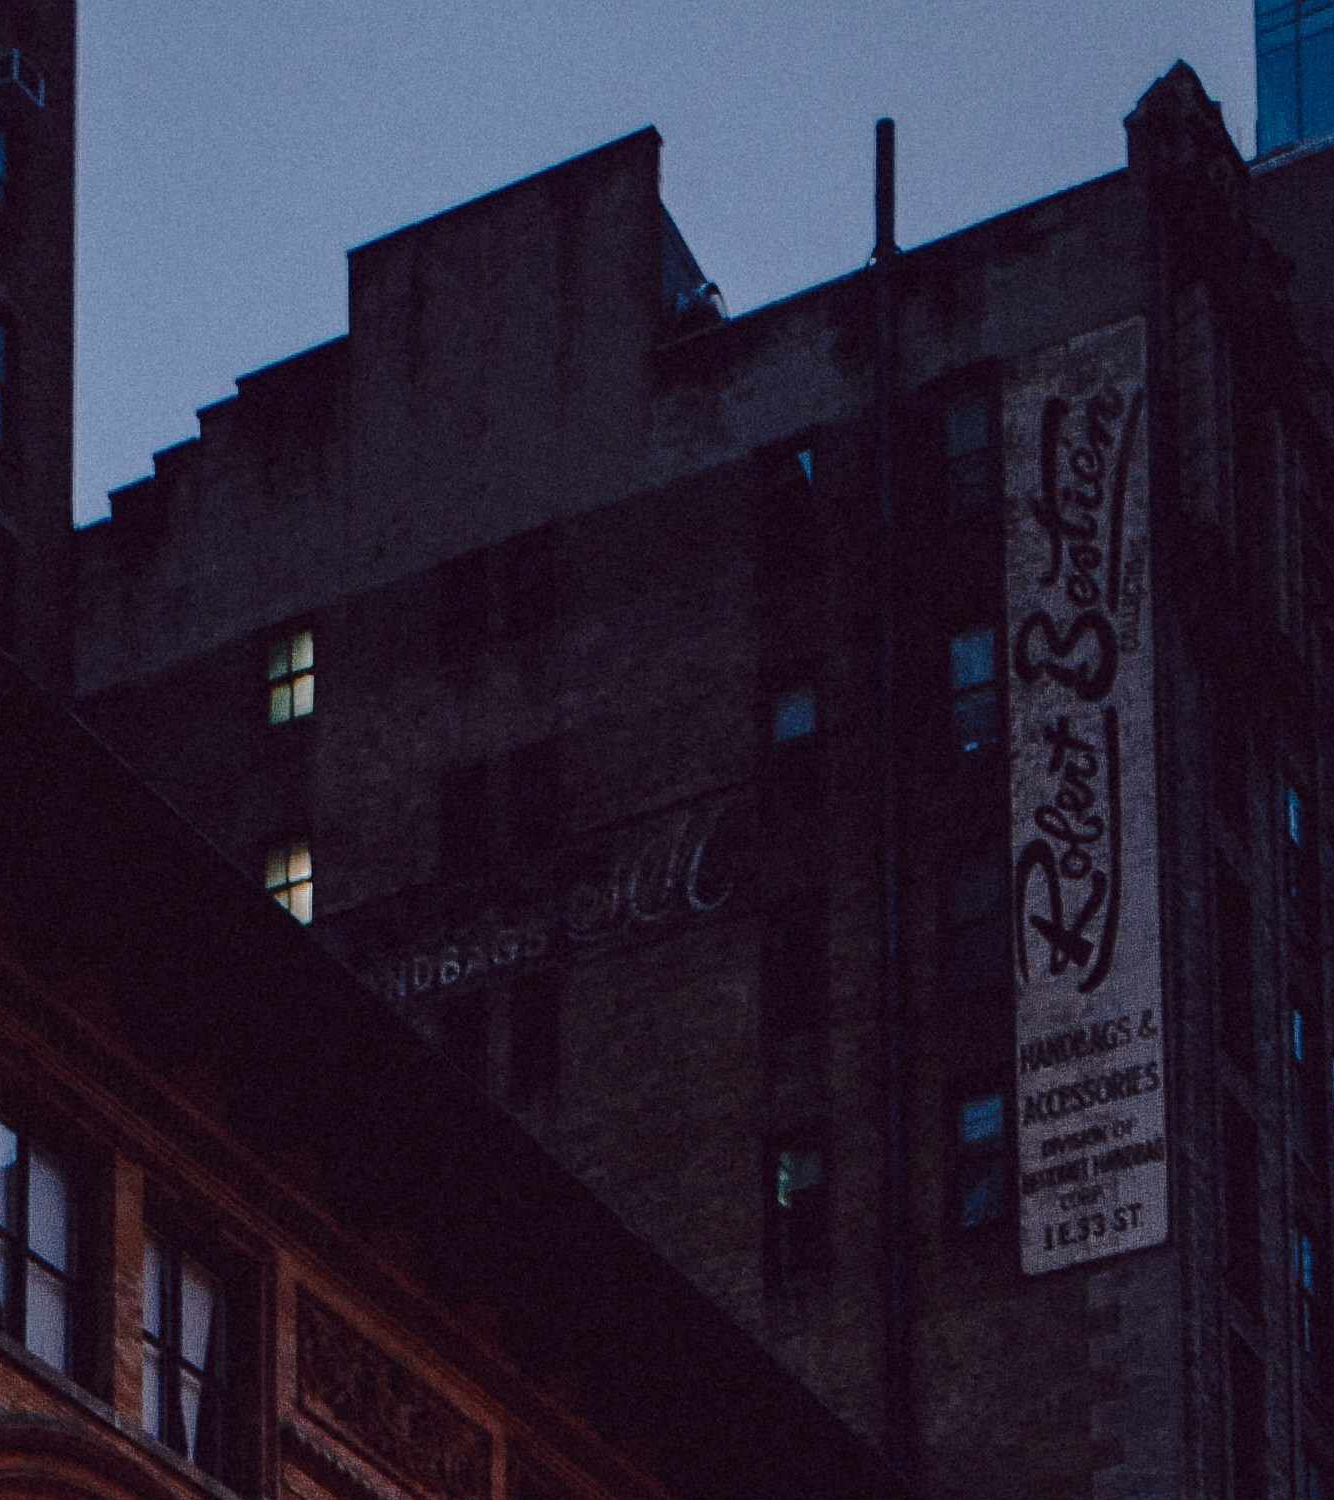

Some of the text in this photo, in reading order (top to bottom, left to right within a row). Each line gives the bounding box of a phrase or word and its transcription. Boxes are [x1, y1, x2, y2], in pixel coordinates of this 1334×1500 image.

[1014, 708, 1119, 992] Robert
[1020, 1010, 1158, 1074] HANDBAGS &
[1023, 1061, 1160, 1127] ACCESSORIES
